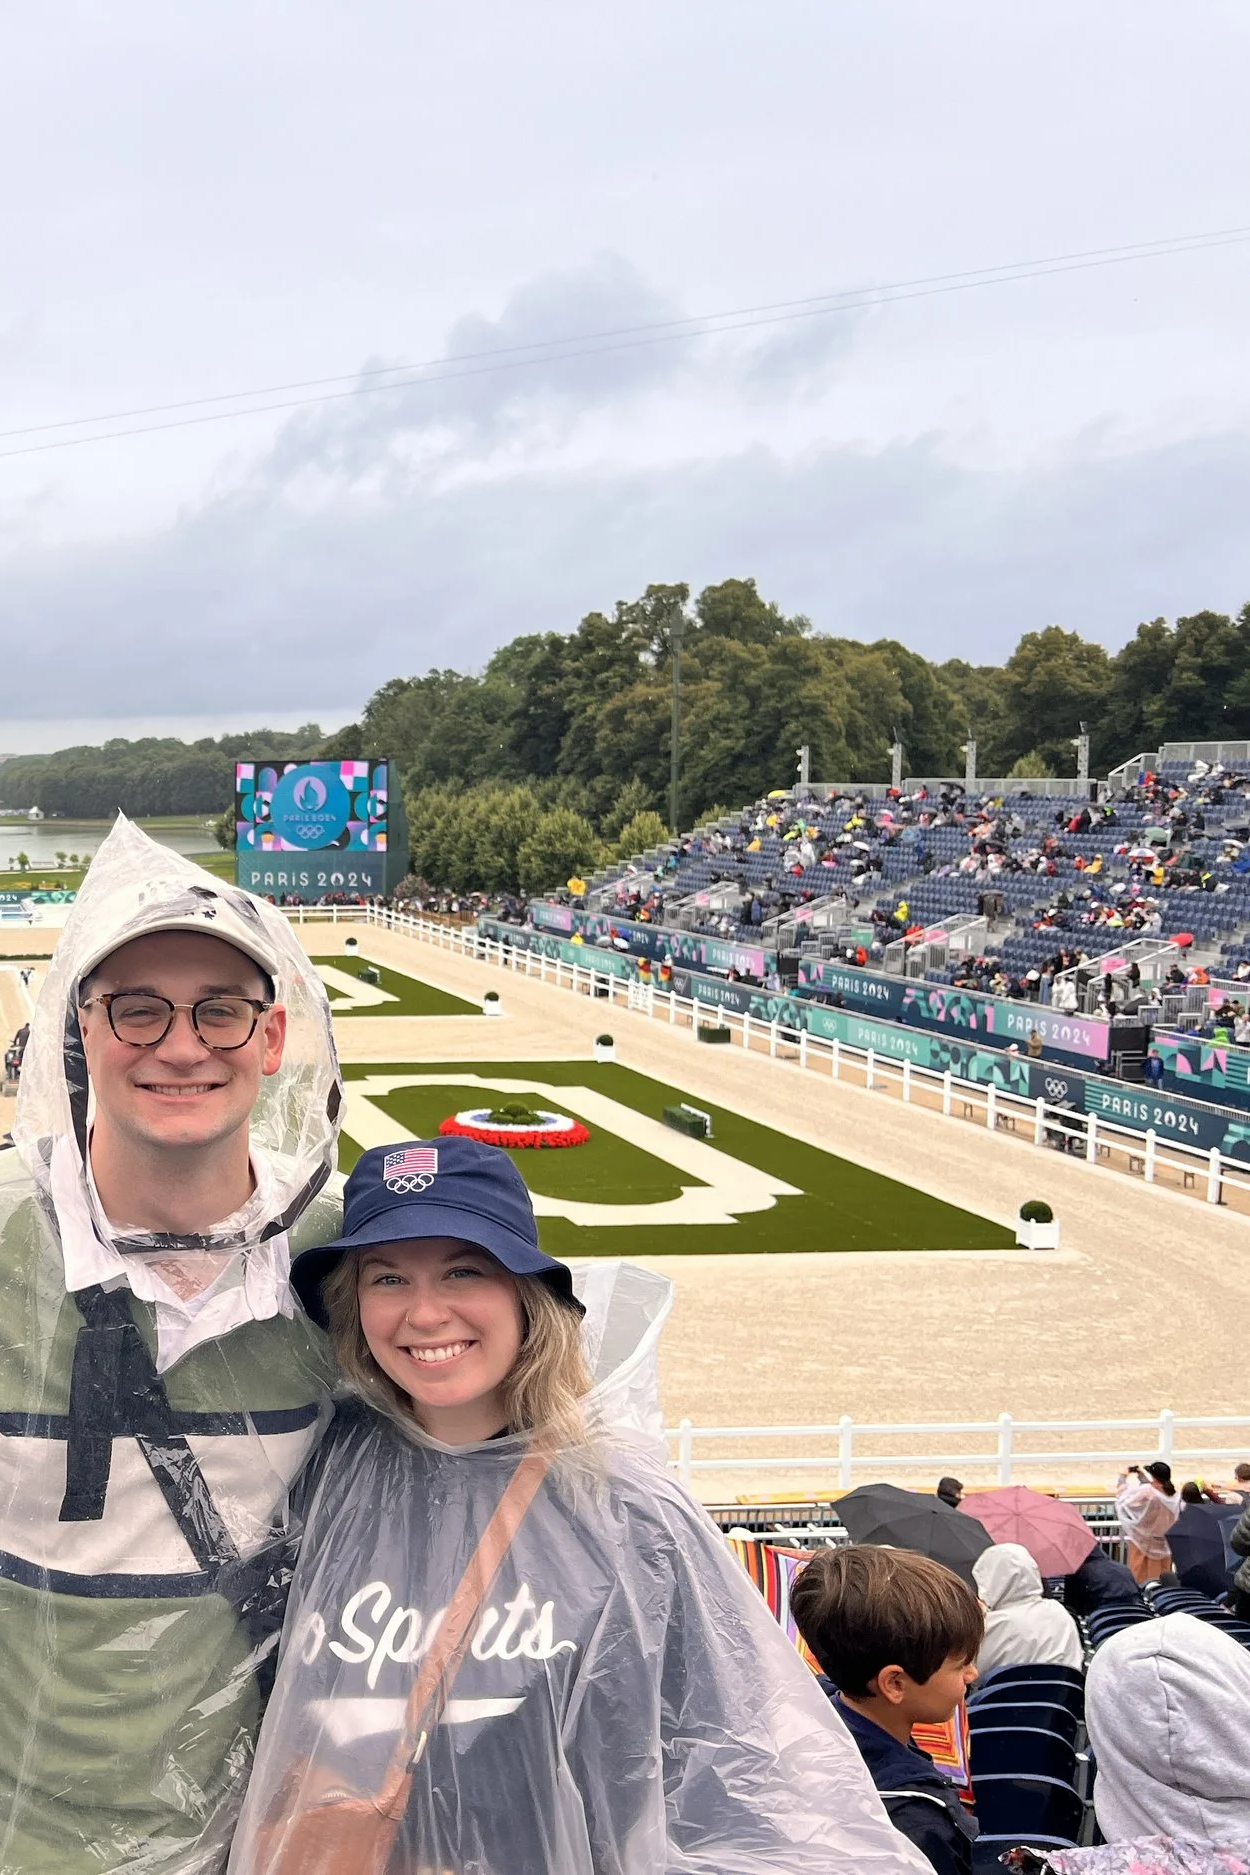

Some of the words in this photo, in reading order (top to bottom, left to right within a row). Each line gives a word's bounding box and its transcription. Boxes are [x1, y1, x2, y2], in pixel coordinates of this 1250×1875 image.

[317, 872, 372, 887] 2024
[862, 982, 889, 1000] 2024
[1052, 1023, 1091, 1046] 2024
[890, 1036, 919, 1056] 2024
[1153, 1108, 1199, 1135] 2024
